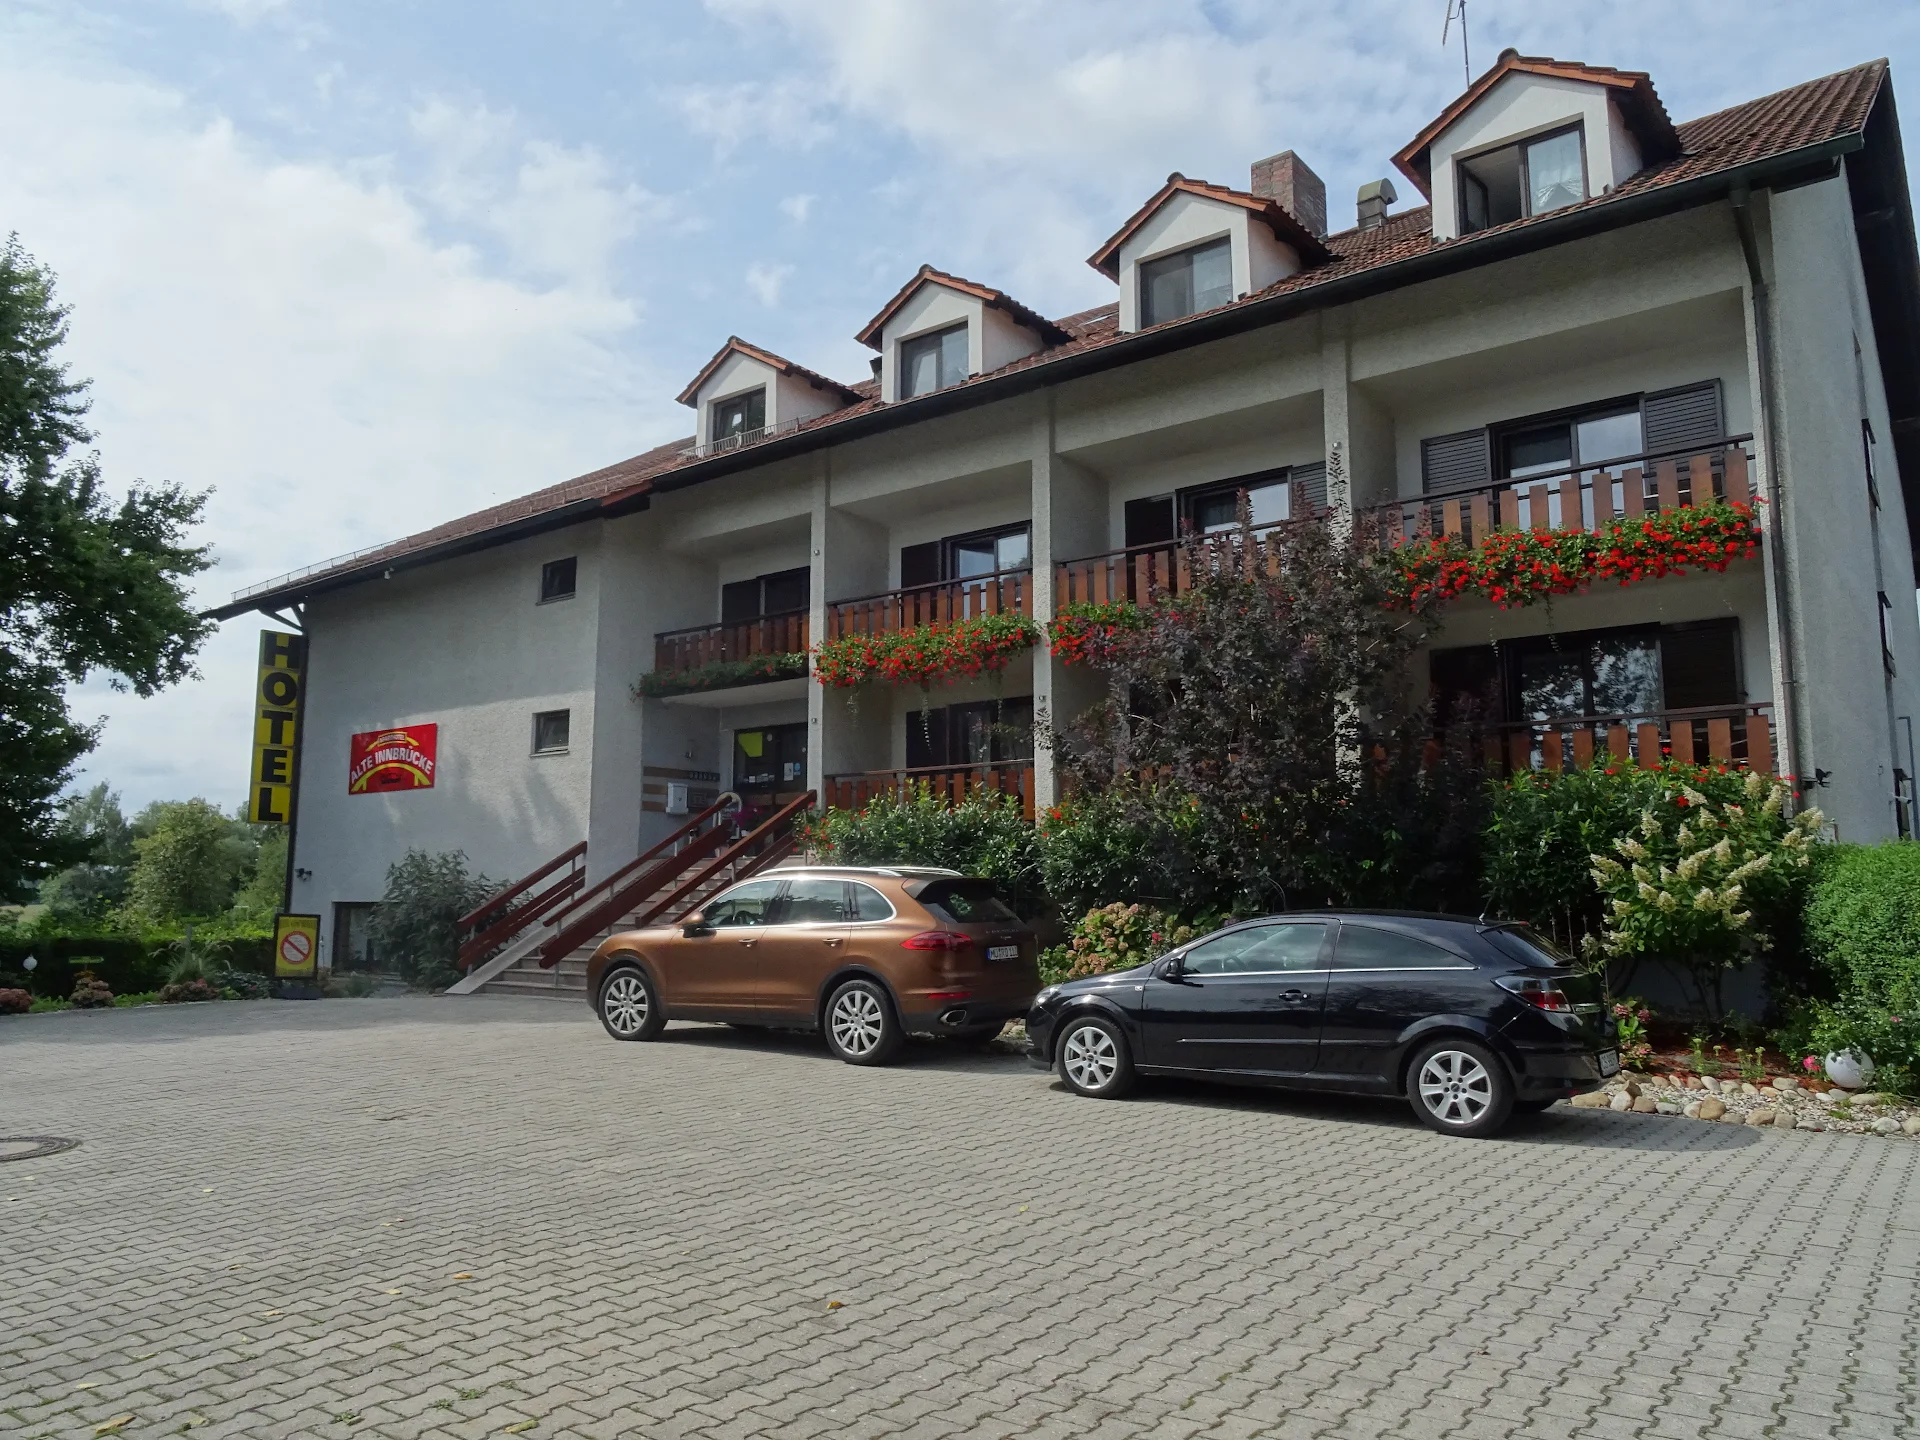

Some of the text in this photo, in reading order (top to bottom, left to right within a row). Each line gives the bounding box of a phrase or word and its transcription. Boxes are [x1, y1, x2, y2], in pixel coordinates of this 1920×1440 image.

[257, 632, 300, 822] HOTEL
[351, 745, 434, 784] ALTE INNBRÜCKE
